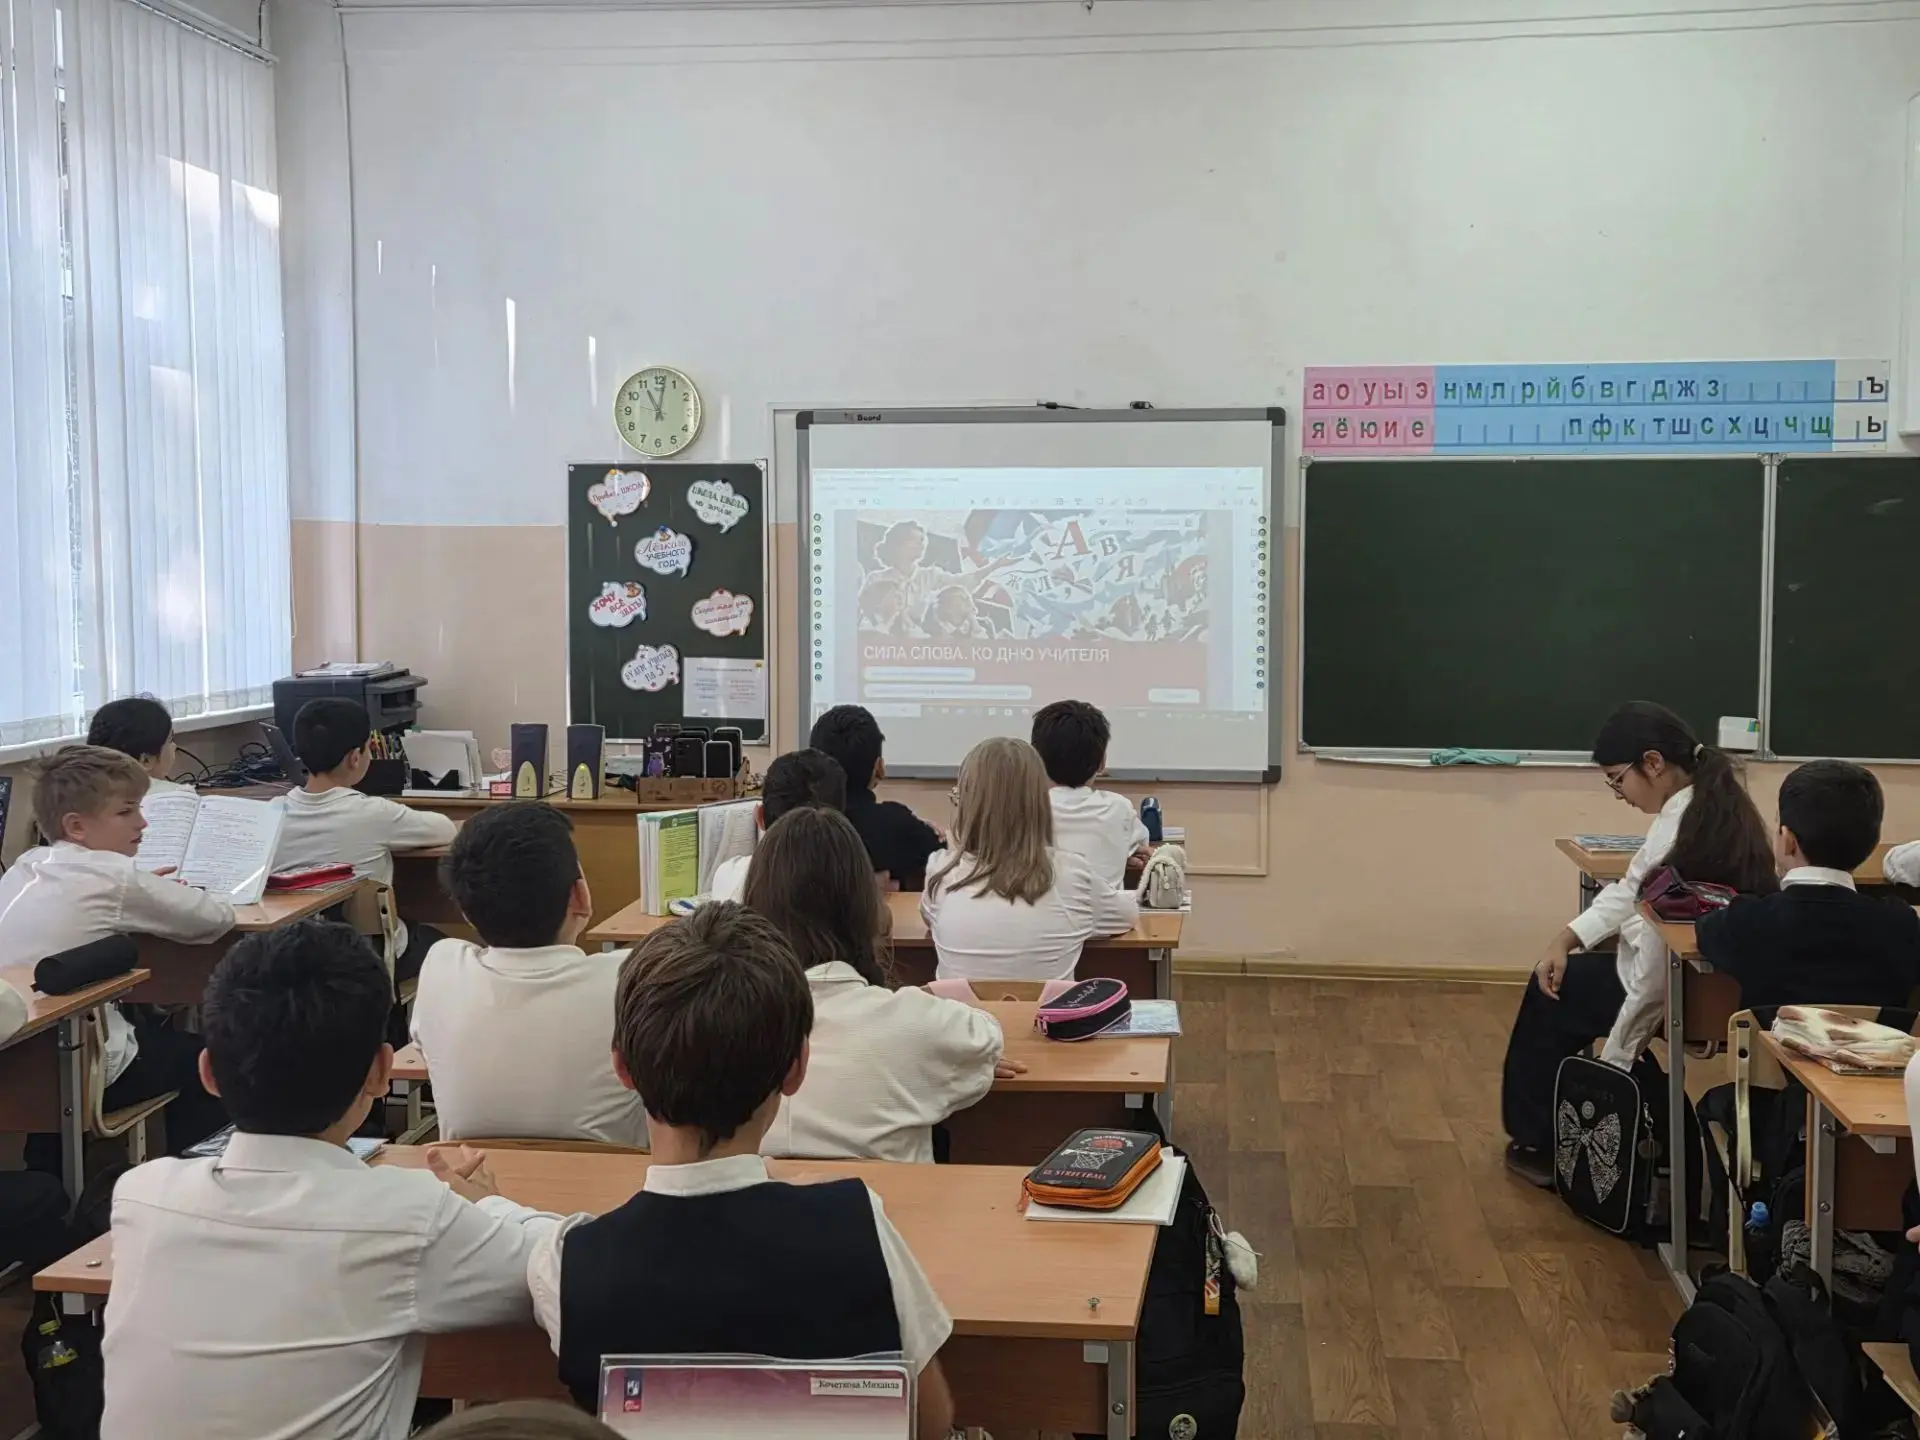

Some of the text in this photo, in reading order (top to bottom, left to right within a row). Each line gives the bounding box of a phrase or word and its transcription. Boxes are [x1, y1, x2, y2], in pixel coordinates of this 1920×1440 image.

[638, 380, 648, 389] 11
[654, 376, 665, 385] 12
[672, 380, 677, 389] 1
[628, 392, 639, 401] 10
[682, 392, 689, 401] 2
[624, 406, 632, 416] 9
[686, 408, 693, 417] 3
[628, 422, 636, 431] 8
[681, 424, 688, 432] 4
[640, 434, 647, 443] 7
[655, 438, 662, 448] 6
[670, 435, 677, 444] 5
[658, 560, 680, 568] ГОДА
[864, 646, 1110, 663] СИЛА СЛОВА. КО ДНЮ УЧИТЕЛЯ
